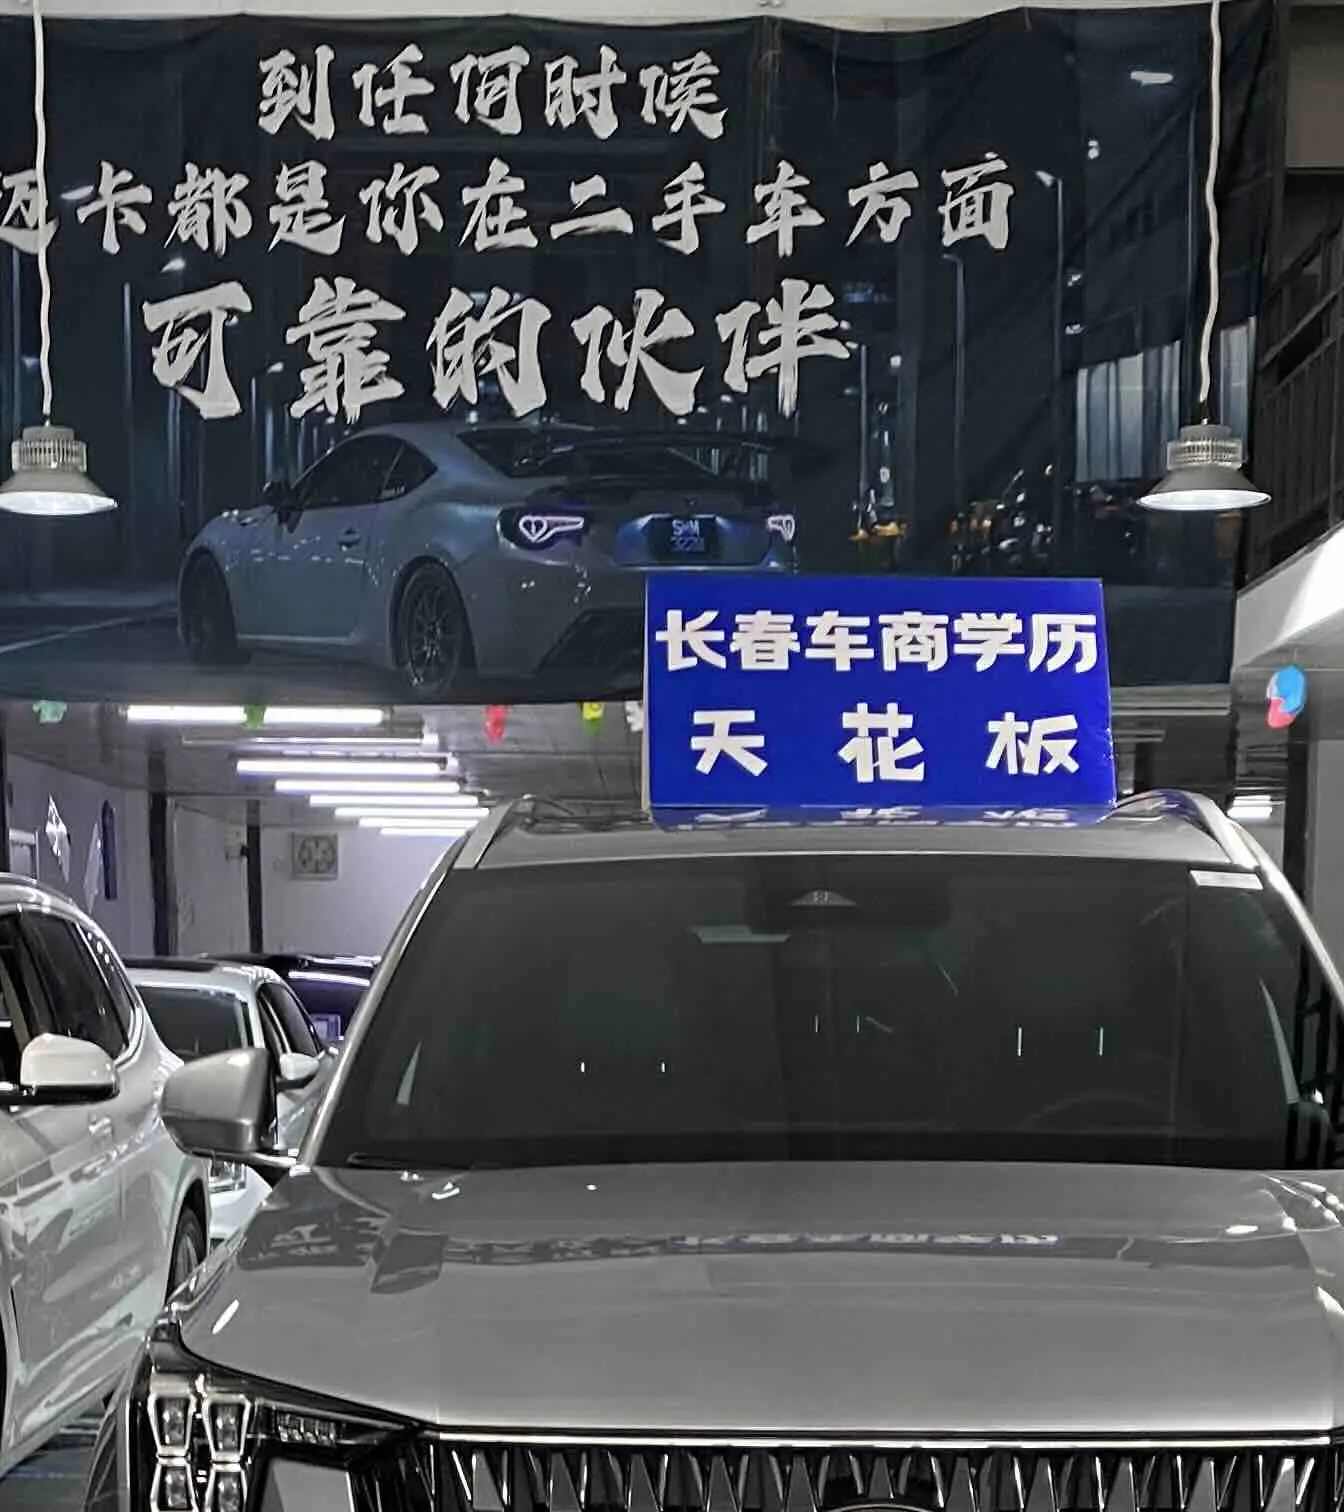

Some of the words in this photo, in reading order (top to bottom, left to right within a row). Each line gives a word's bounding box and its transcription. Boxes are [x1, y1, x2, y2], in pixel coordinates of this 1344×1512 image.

[258, 43, 728, 141] 到任何时候
[142, 276, 850, 424] 可靠的伙伴
[655, 609, 1098, 673] 长春车商学历
[690, 702, 1081, 783] 天花板
